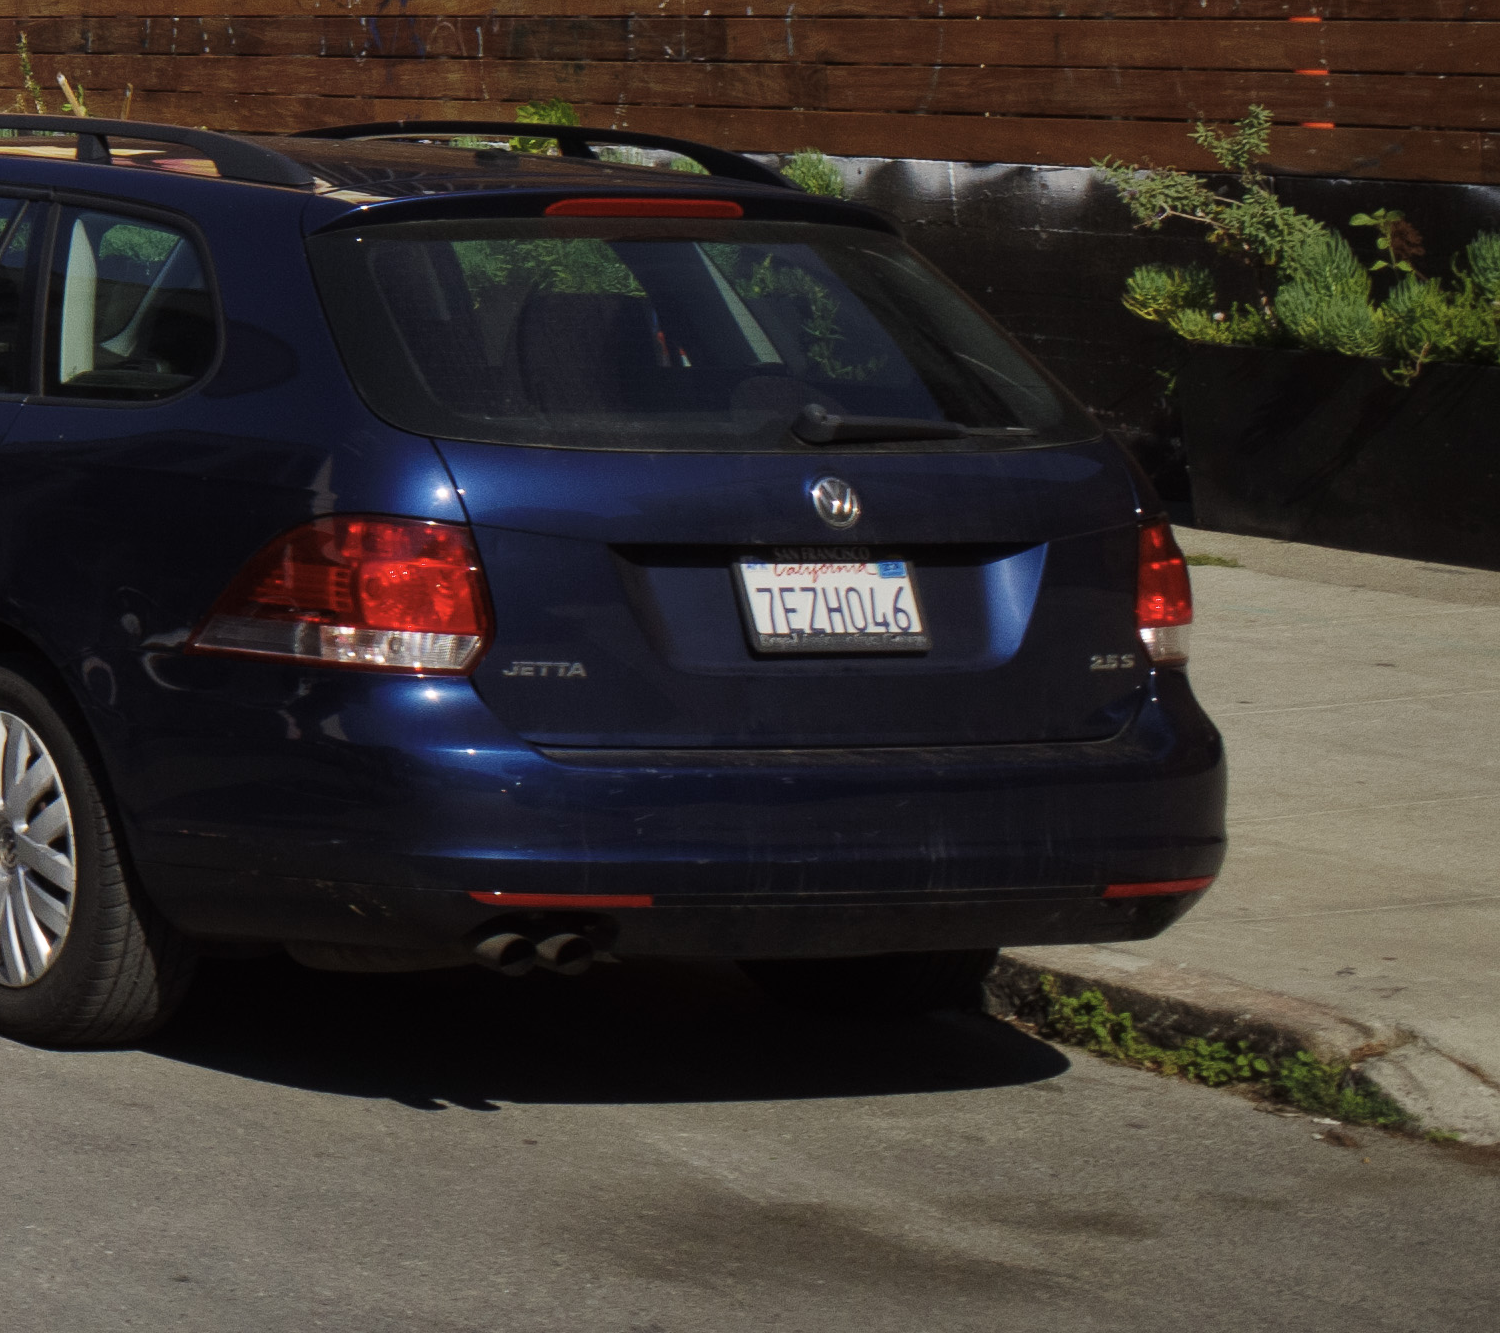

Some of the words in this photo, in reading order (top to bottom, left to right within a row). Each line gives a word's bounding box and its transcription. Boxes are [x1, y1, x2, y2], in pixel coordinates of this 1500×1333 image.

[801, 546, 870, 561] FRANCISCO
[773, 563, 877, 583] California
[756, 586, 911, 633] 7EZH046
[502, 661, 588, 677] JETTA
